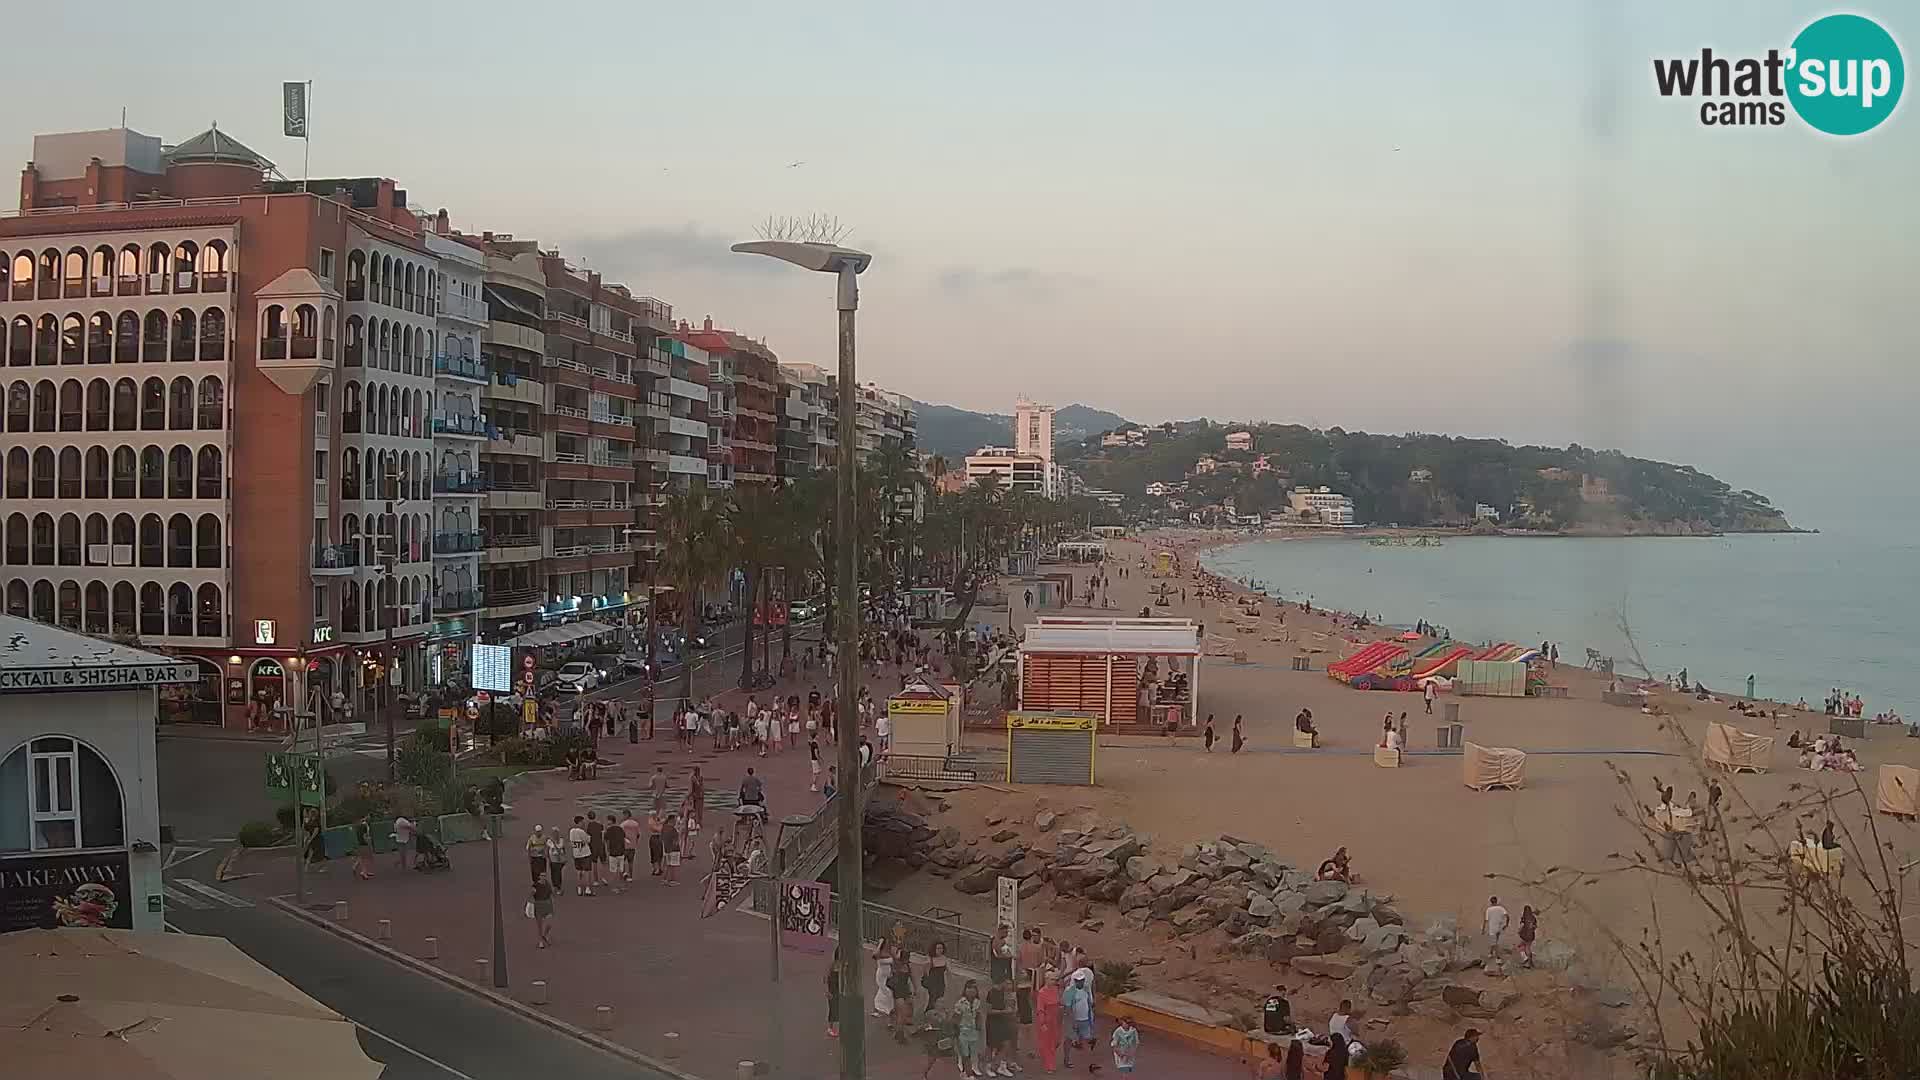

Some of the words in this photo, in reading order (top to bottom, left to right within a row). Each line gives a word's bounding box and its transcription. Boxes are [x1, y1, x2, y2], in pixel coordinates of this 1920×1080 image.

[313, 626, 333, 644] KFC
[1, 671, 58, 687] CKTAIL
[63, 671, 74, 684] &
[79, 668, 140, 684] SHISHA
[145, 667, 177, 682] BAR
[257, 665, 281, 675] KFC
